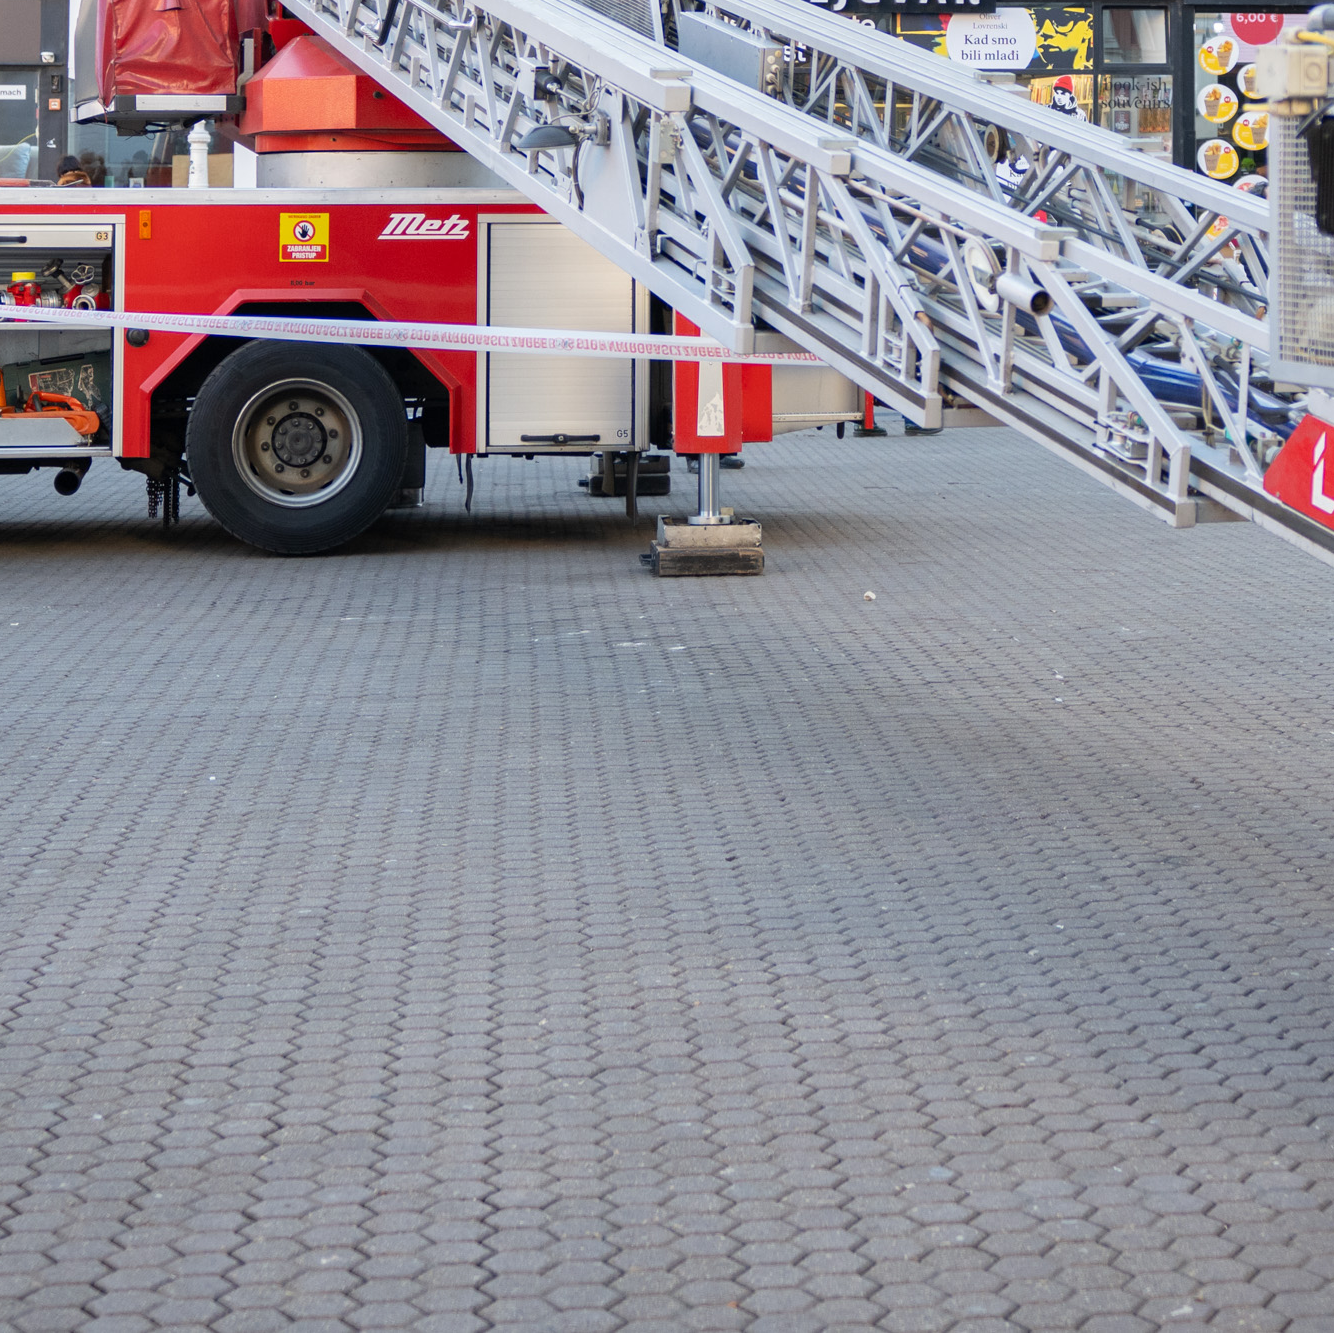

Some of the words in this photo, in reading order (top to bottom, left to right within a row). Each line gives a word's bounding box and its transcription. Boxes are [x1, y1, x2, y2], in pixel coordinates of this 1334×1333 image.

[1236, 13, 1266, 24] 6,00
[972, 22, 1008, 30] Lovrenski
[964, 34, 989, 45] Kad
[992, 37, 1017, 45] smo
[961, 50, 981, 60] bili
[985, 50, 1019, 60] mlađi
[1104, 77, 1167, 90] book-ish
[1101, 97, 1171, 109] souvenirs
[377, 213, 469, 240] Metz
[96, 232, 109, 240] G3
